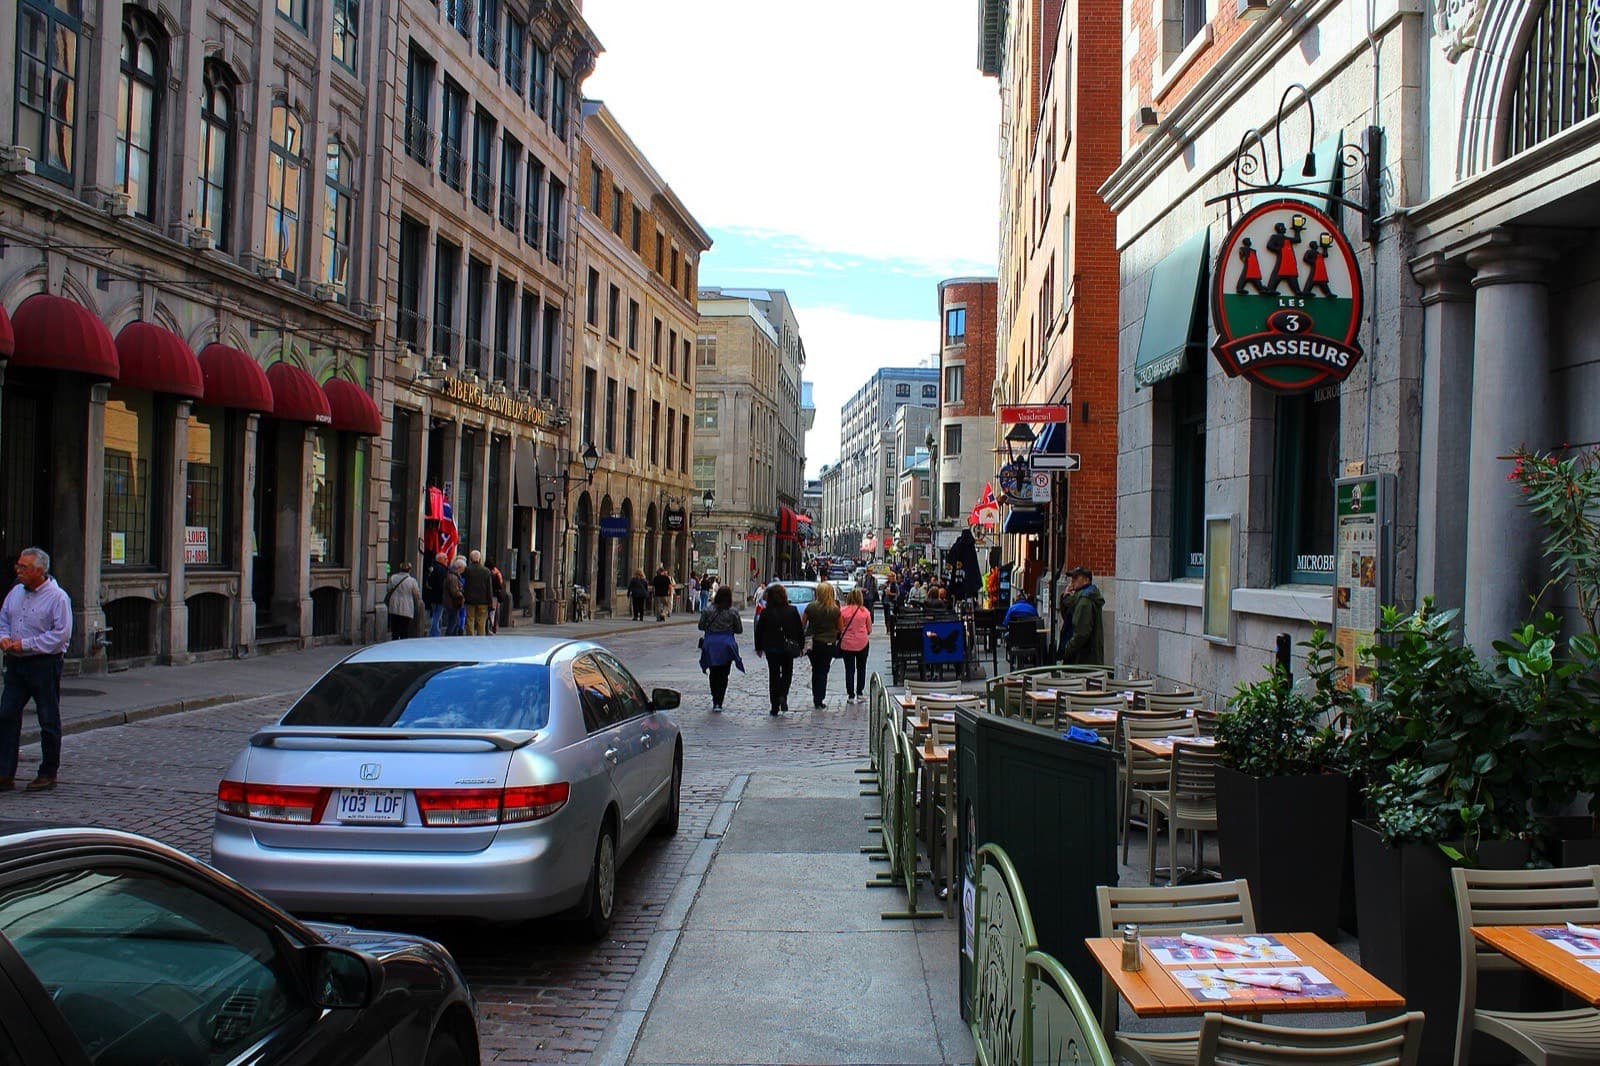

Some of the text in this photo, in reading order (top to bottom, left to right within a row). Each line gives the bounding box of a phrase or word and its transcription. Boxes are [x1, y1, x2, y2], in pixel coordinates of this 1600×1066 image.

[1279, 298, 1305, 307] LES
[1286, 314, 1300, 331] 3
[1235, 340, 1350, 367] BRASSEURS
[188, 531, 206, 543] LOUER
[342, 795, 402, 813] Y03 LDF
